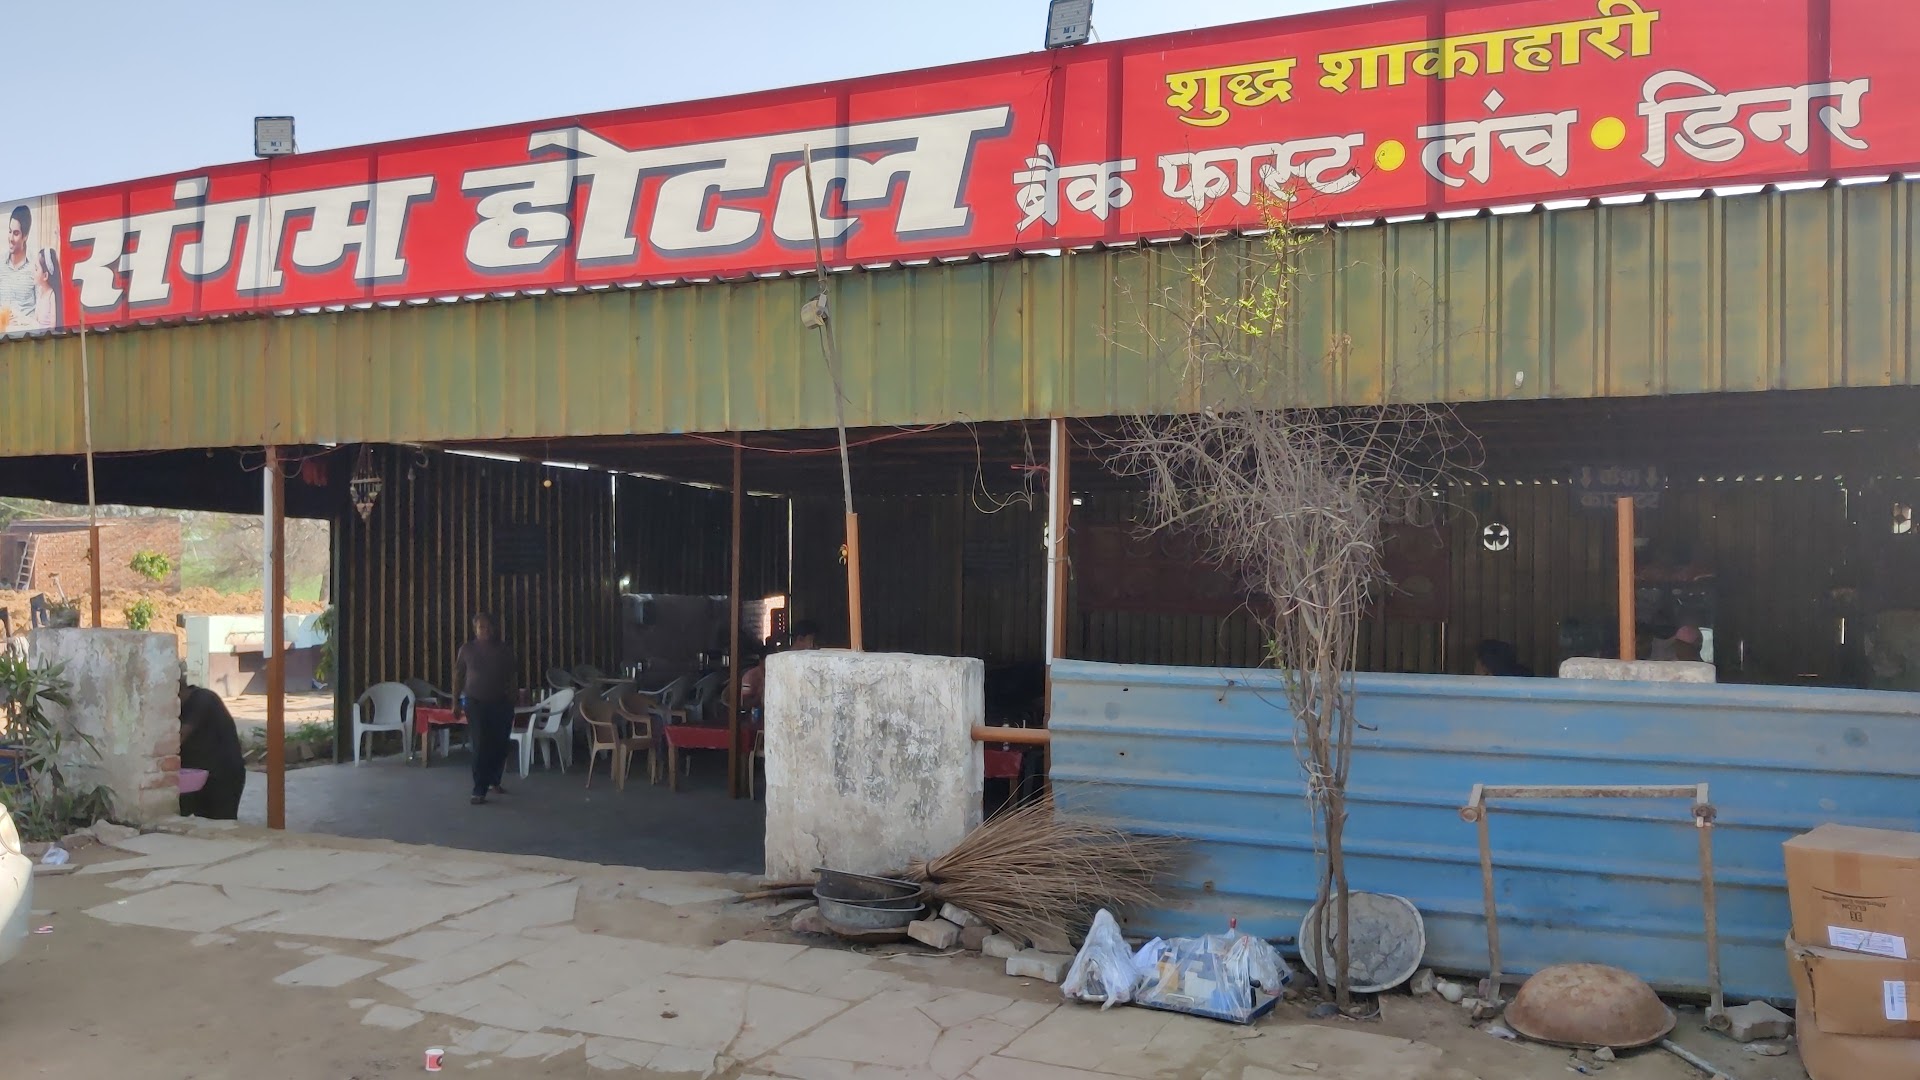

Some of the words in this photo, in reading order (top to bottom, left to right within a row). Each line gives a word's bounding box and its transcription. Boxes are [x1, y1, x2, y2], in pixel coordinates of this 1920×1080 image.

[1166, 57, 1297, 128] शुद्ध
[1416, 89, 1578, 188] लंच
[1639, 70, 1870, 168] डिनर
[69, 176, 436, 310] संगम
[461, 106, 1012, 270] होटल
